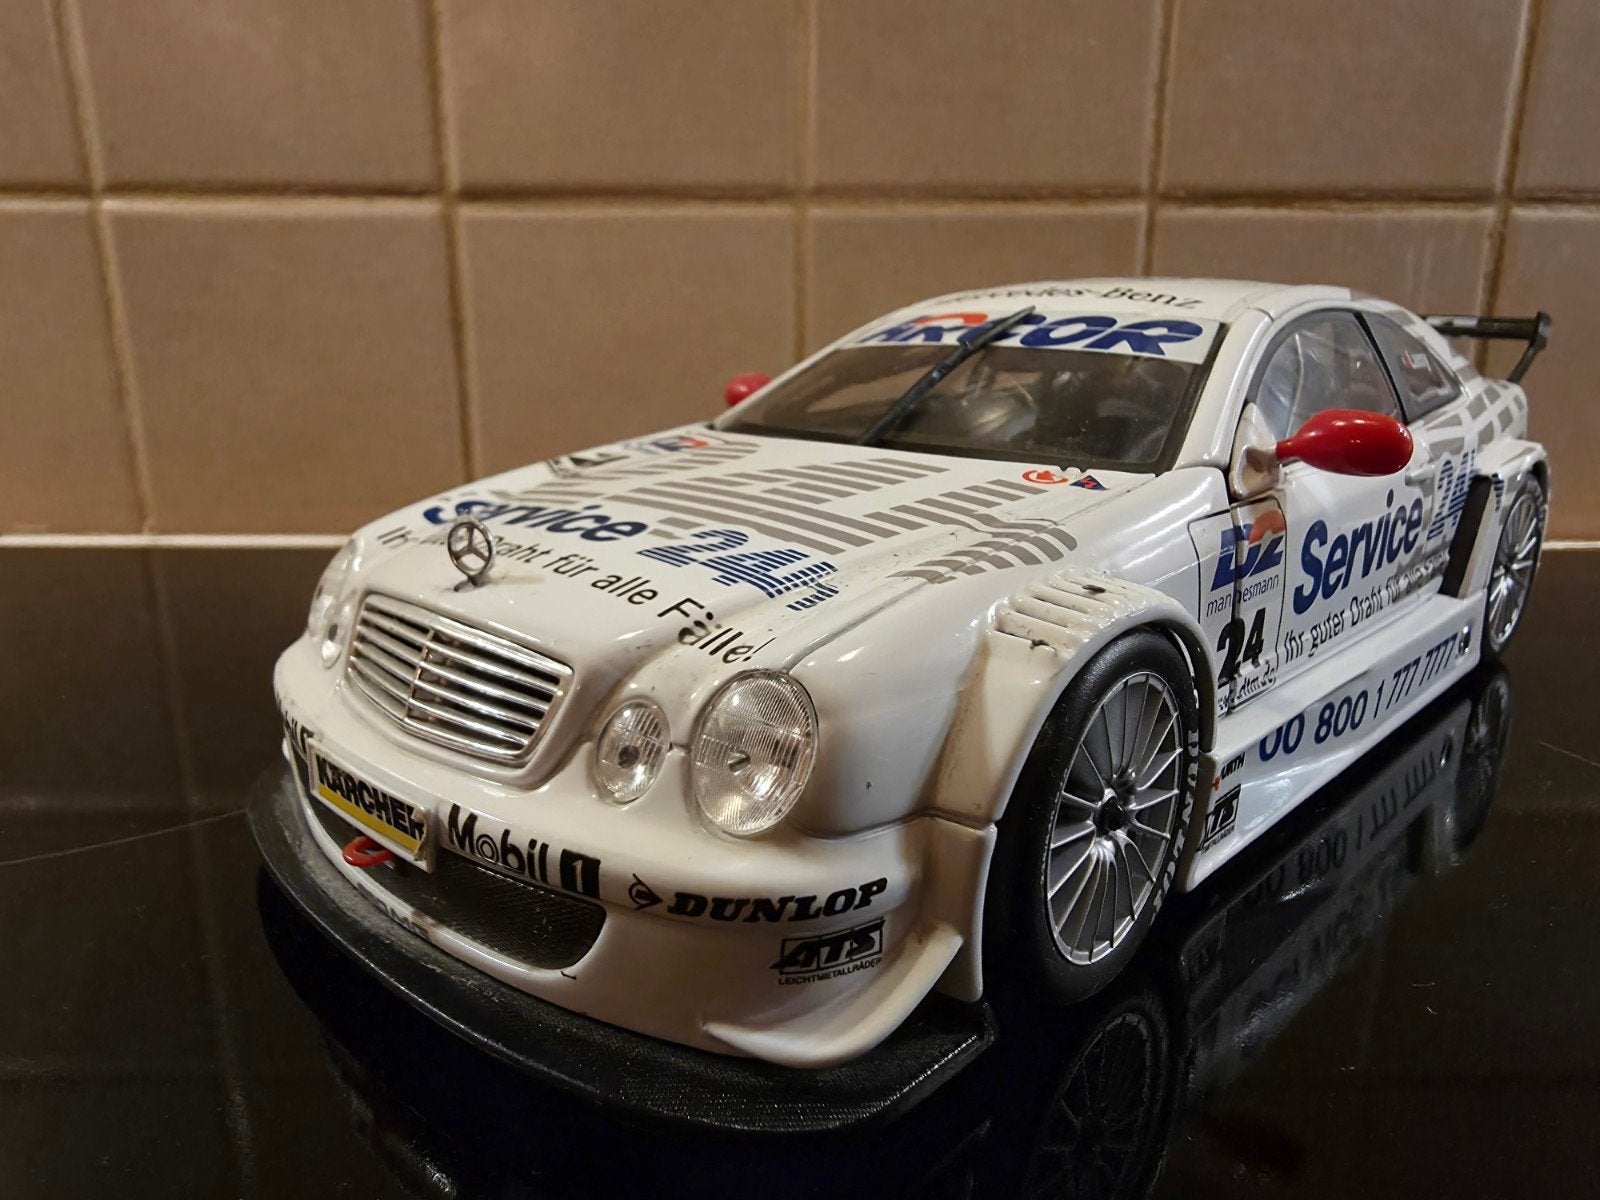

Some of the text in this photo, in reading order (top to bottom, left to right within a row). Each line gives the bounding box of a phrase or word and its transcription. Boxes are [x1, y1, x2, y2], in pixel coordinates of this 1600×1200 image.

[423, 500, 648, 542] Service
[1293, 489, 1424, 615] Service
[541, 552, 599, 579] für
[591, 573, 659, 606] alle
[657, 597, 778, 664] Fälle!
[1283, 627, 1307, 664] Ihr
[1310, 607, 1346, 657] guter
[1350, 585, 1385, 625] Draht
[1216, 607, 1266, 690] 24
[1314, 690, 1368, 744] 800
[1385, 661, 1421, 711] 777
[448, 803, 549, 883] Mobil
[667, 877, 888, 923] DUNLOP
[769, 919, 886, 970] ATS
